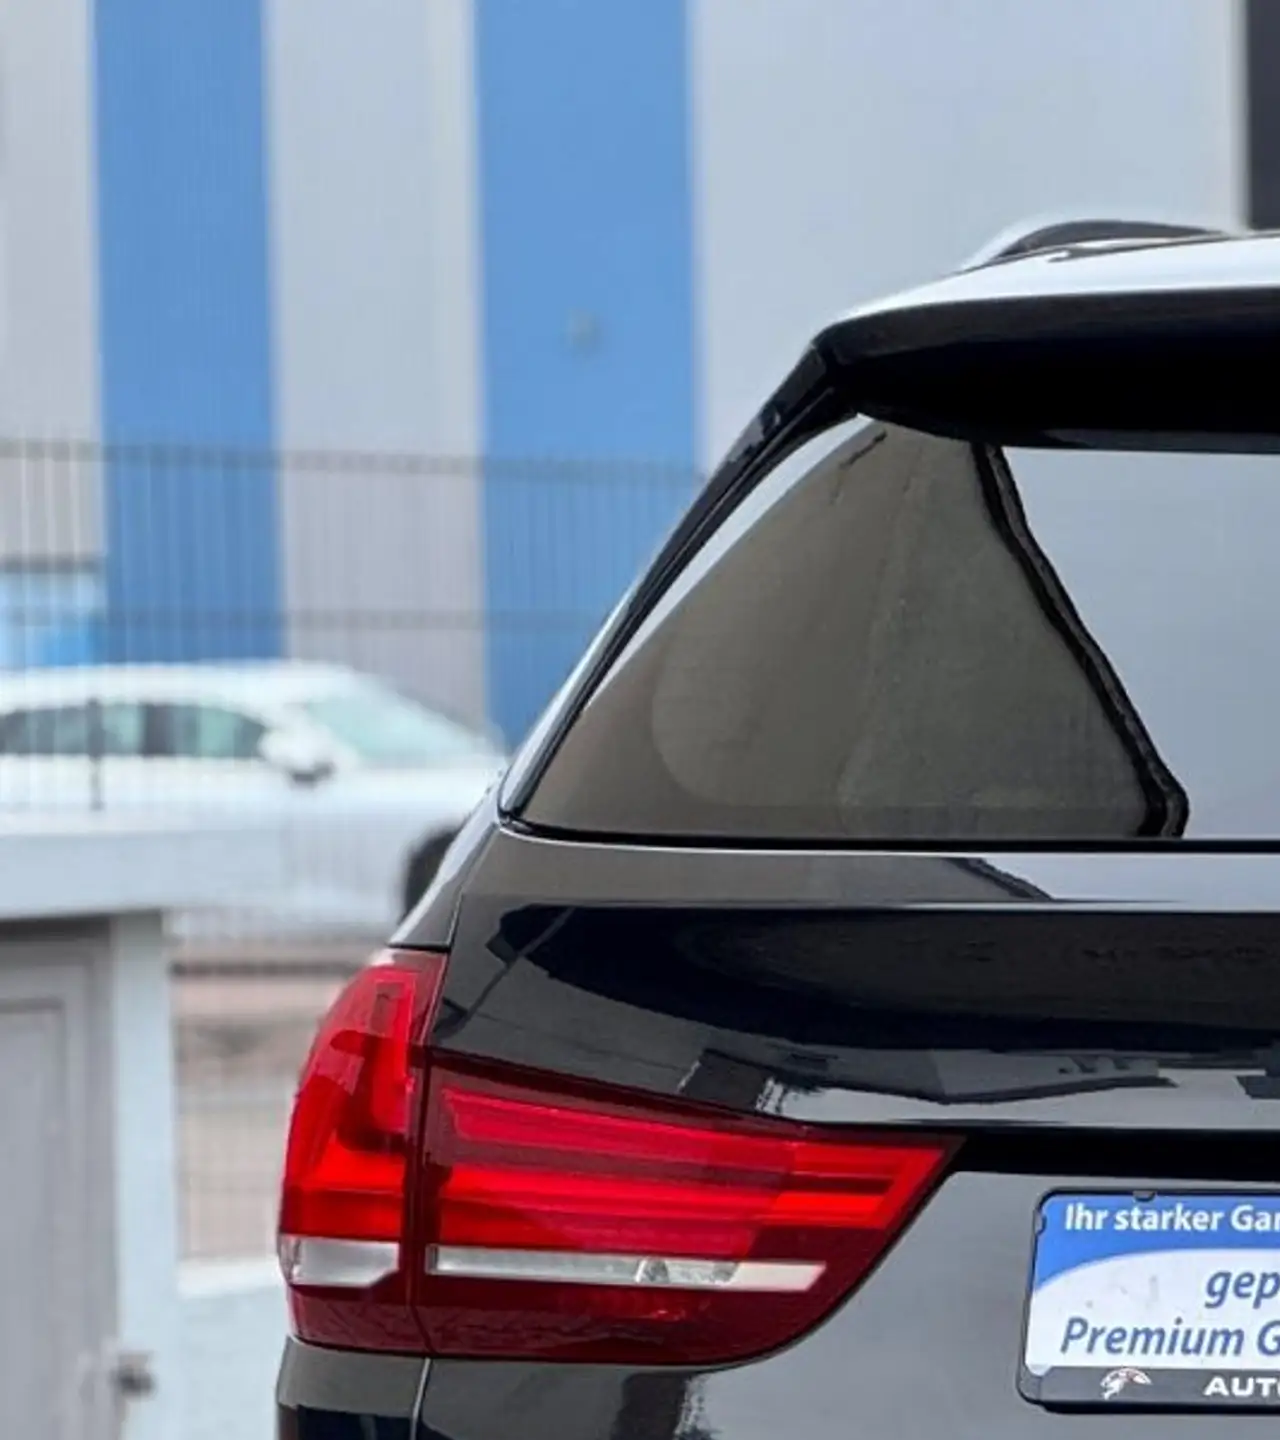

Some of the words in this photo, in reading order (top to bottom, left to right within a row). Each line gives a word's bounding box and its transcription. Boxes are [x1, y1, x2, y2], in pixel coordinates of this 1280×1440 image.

[1065, 1202, 1108, 1231] Ihr
[1113, 1203, 1224, 1232] starker
[1060, 1316, 1245, 1356] Premium
